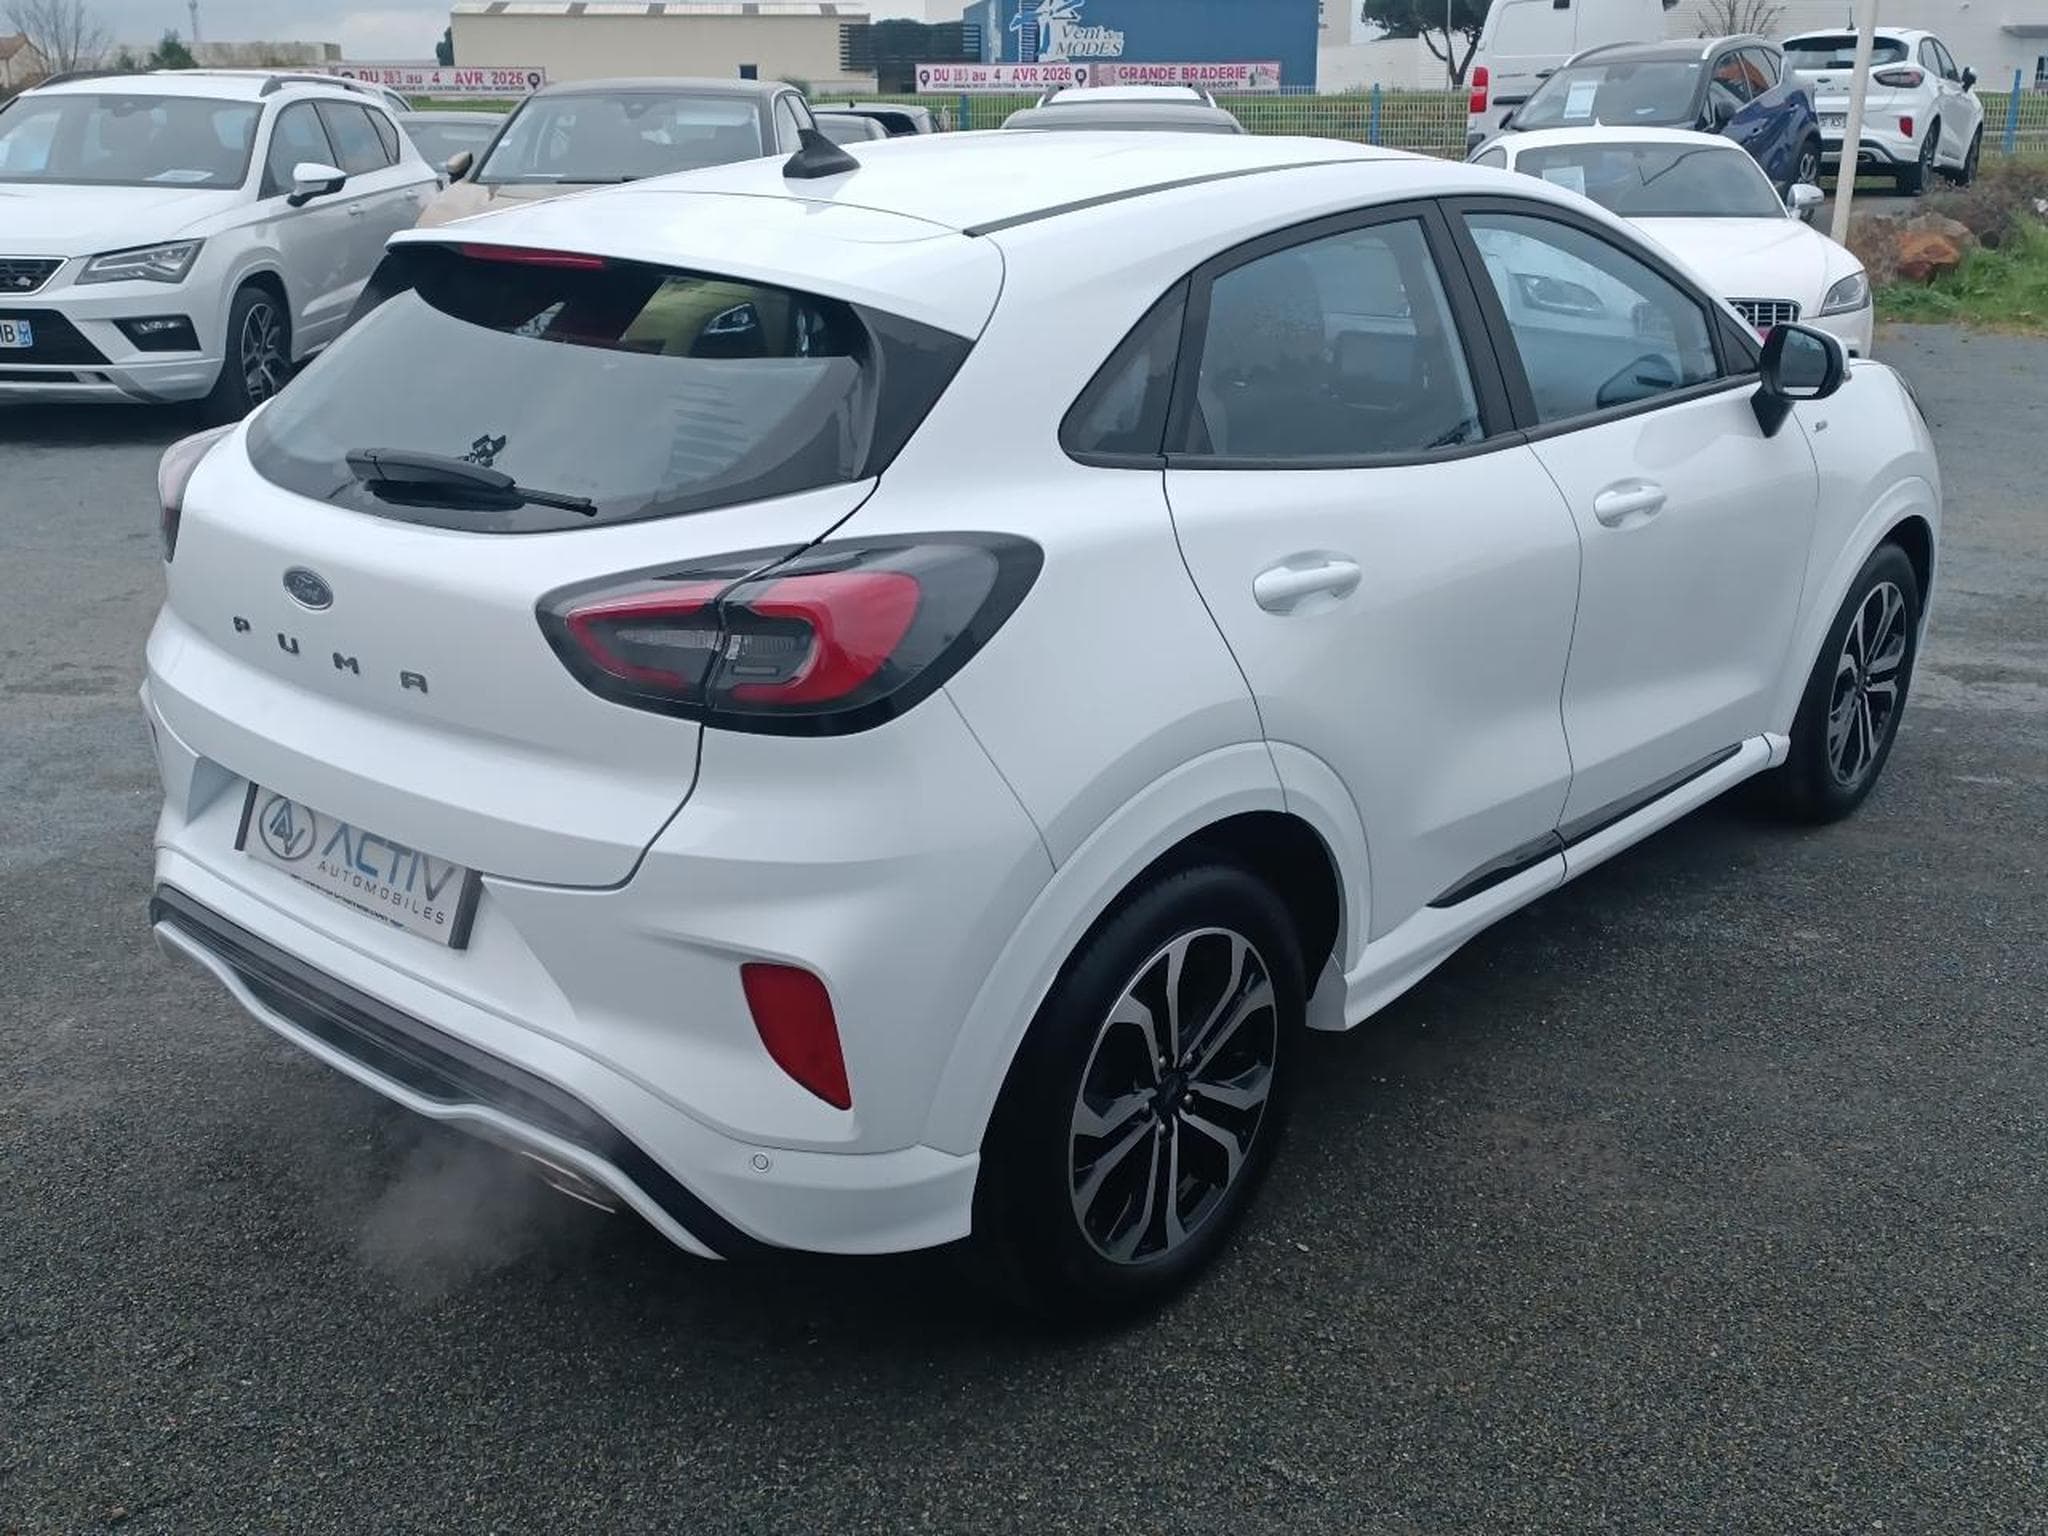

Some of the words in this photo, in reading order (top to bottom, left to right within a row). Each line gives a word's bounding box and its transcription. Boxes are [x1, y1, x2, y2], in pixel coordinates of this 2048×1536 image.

[1056, 41, 1121, 55] MODES
[359, 70, 379, 84] DU
[432, 71, 441, 83] 4
[455, 71, 483, 84] AVR
[491, 71, 524, 85] 2026
[933, 68, 950, 82] DU
[972, 71, 987, 81] au
[994, 68, 1001, 80] 4
[1012, 67, 1038, 81] AVR
[1042, 67, 1072, 81] 2026
[1118, 66, 1177, 80] GRANDE
[1181, 66, 1247, 80] BRADERIE
[232, 615, 429, 694] PUMA
[321, 822, 457, 902] ACTIV
[318, 860, 445, 925] AUTOMOBILES
